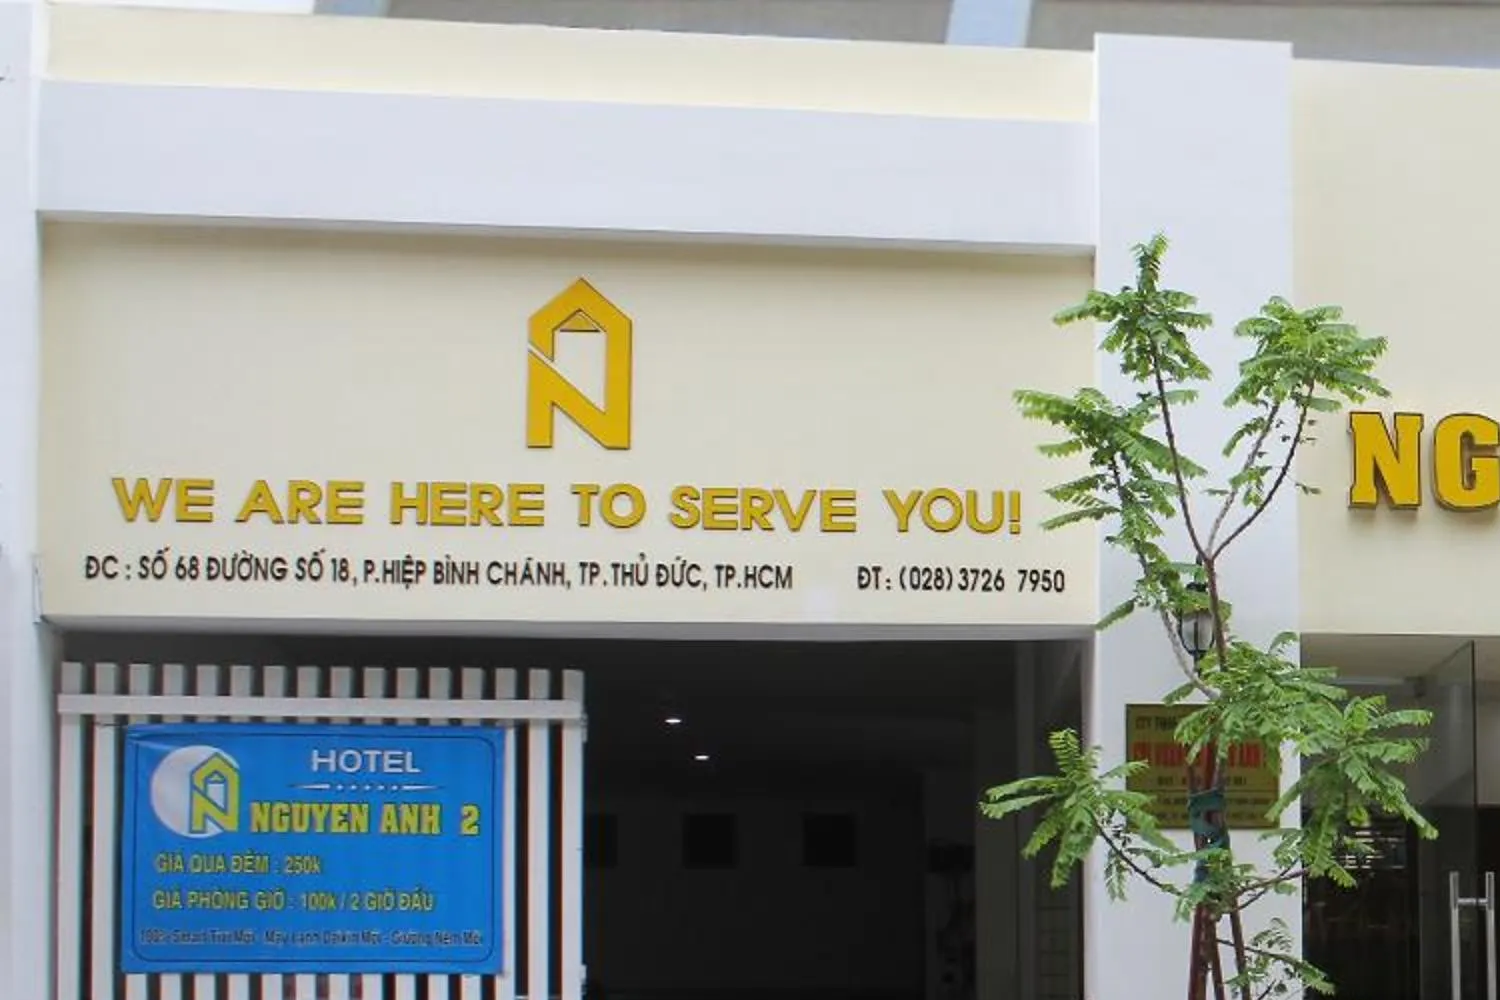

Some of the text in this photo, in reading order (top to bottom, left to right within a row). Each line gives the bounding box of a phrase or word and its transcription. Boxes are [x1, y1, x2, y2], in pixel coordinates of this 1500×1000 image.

[111, 478, 1021, 534] WE ARE HERE TO SERVE YOU!
[137, 547, 170, 580] SỐ
[175, 555, 200, 581] 68
[206, 549, 288, 581] ĐƯỜNG
[295, 547, 326, 581] SỐ
[433, 554, 480, 586] BÌNH
[1018, 569, 1065, 592] 7950
[310, 748, 422, 774] HOTEL
[249, 801, 482, 837] NGUYEN ANH 2
